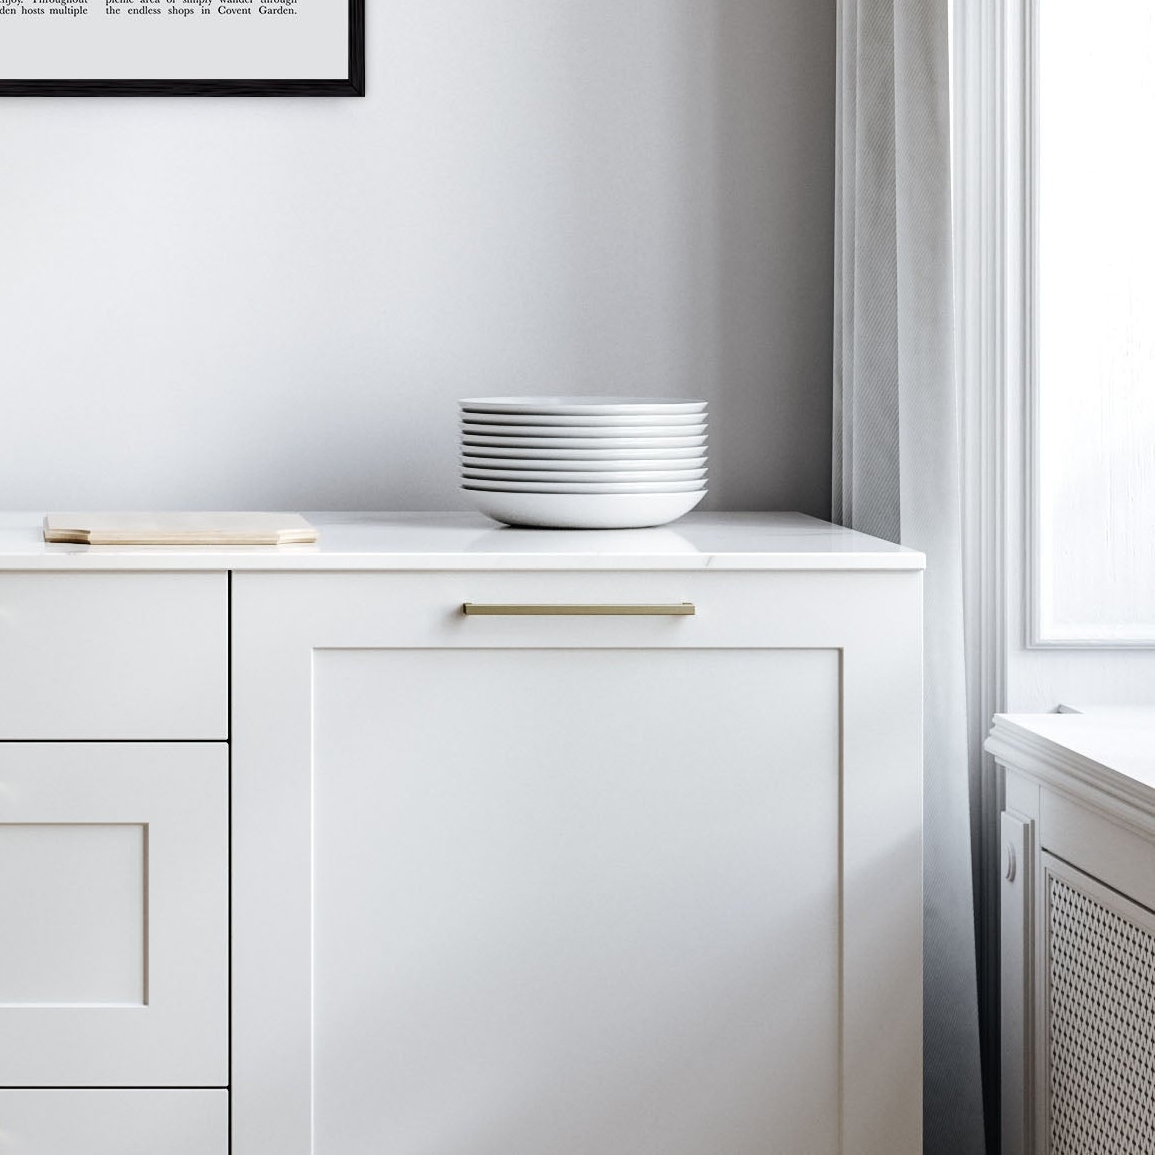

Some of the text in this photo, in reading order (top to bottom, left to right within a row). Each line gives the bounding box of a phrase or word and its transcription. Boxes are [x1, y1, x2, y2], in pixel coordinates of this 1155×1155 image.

[21, 6, 45, 14] hosts
[49, 6, 88, 17] multiple
[106, 6, 297, 17] the endless shops in Covent Garden.
